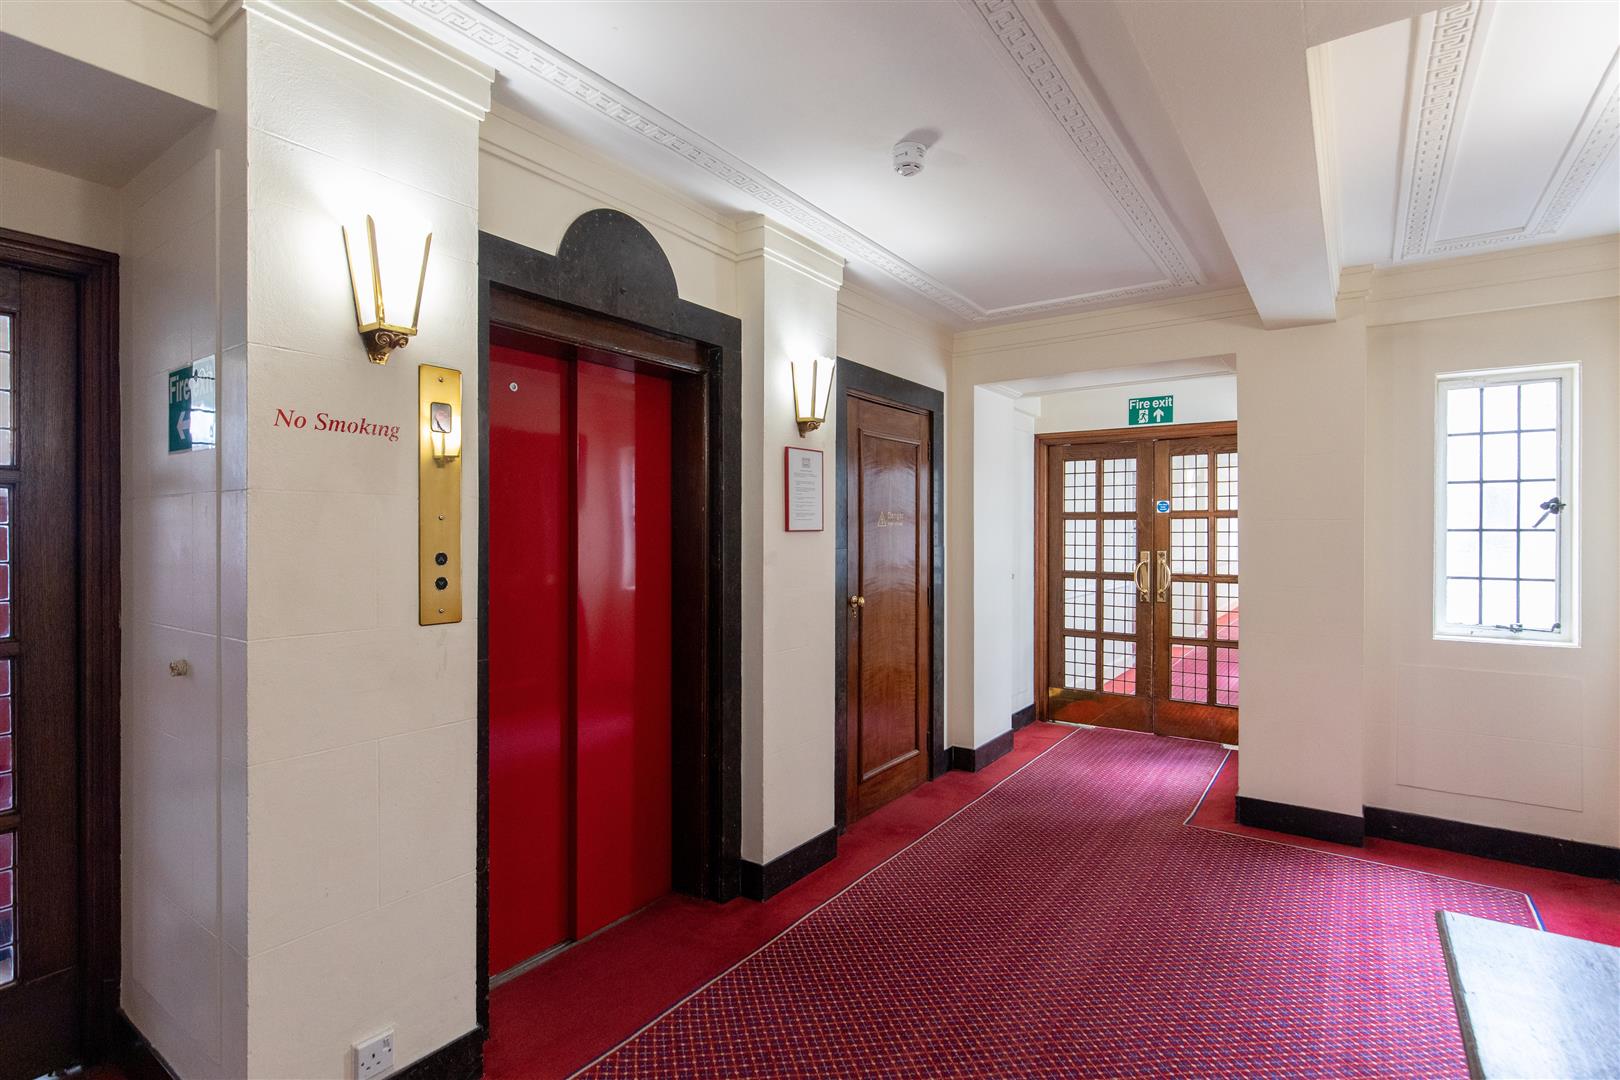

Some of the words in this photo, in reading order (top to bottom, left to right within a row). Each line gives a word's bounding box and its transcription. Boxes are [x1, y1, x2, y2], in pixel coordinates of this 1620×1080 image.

[170, 375, 191, 404] Fire
[1130, 400, 1150, 410] Fire
[1152, 397, 1172, 408] exit
[273, 408, 307, 429] No
[314, 412, 400, 442] Smoking
